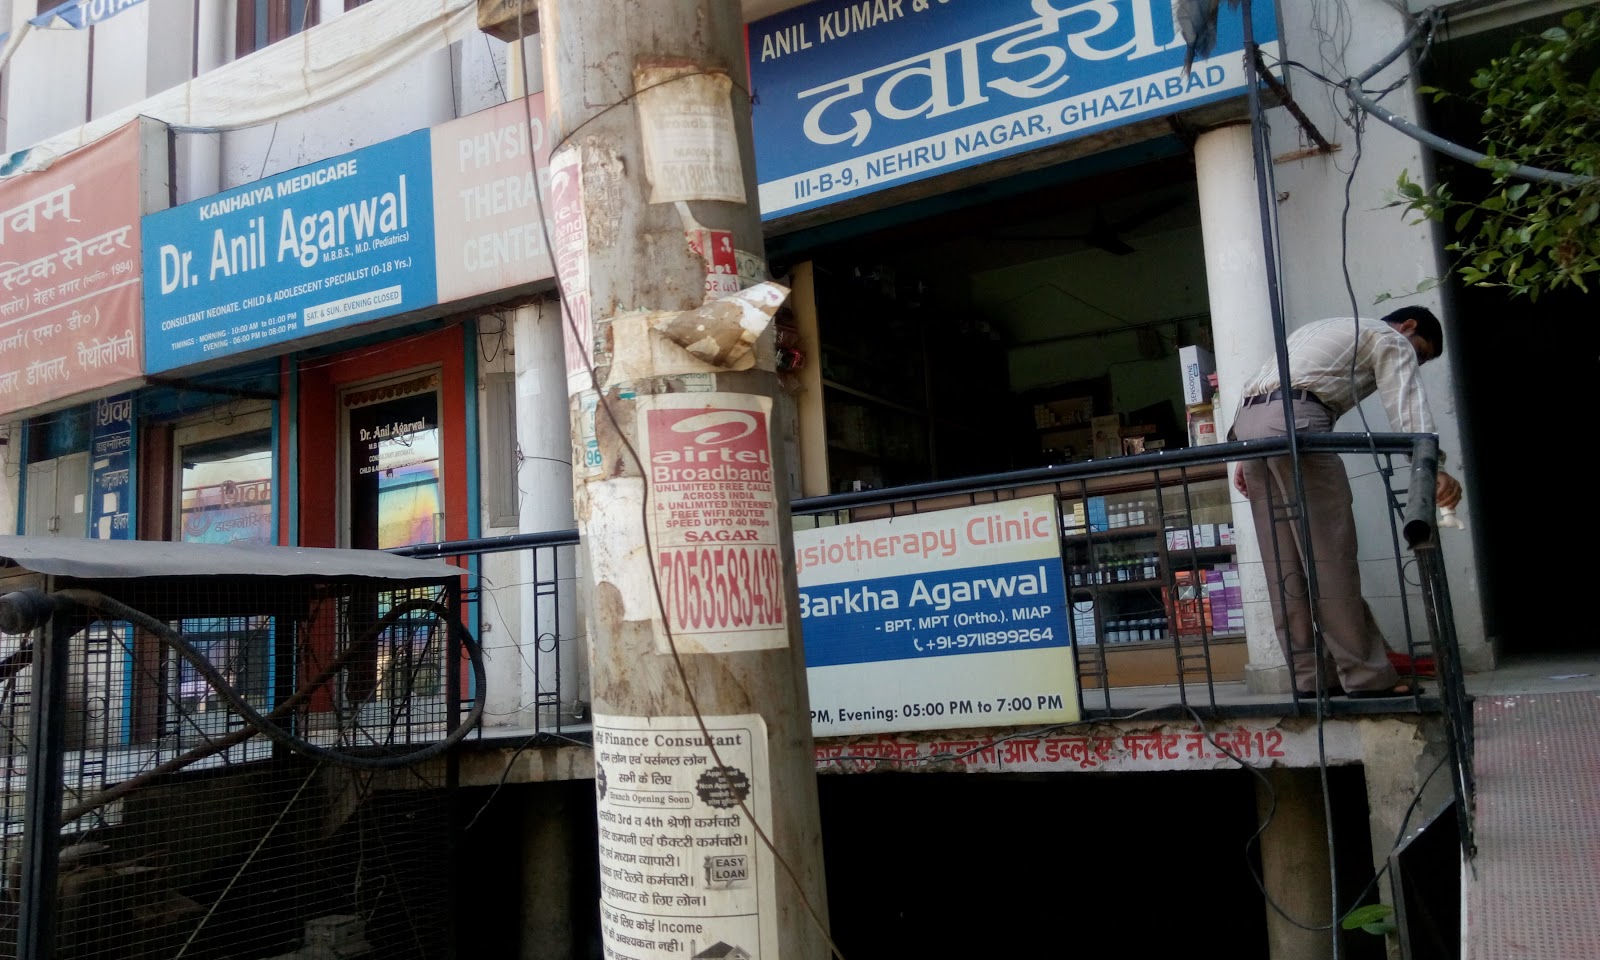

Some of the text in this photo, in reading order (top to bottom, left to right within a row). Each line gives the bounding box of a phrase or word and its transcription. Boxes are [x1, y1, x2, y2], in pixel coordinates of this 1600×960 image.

[761, 23, 812, 62] ANIL
[819, 0, 904, 43] KUMAR
[794, 65, 1225, 199] III-B-9, NEHRU NAGAR, GHAZIABAD
[458, 117, 543, 173] PHYSIO
[200, 159, 357, 221] KANHAIYA MEDICARE
[460, 166, 552, 222] THERAP
[160, 174, 408, 295] Dr. Anil Agarwal
[355, 241, 371, 254] M.D.
[373, 230, 409, 251] (Pediatrics)
[161, 310, 205, 331] CONSULTANT
[243, 295, 265, 310] CHILD
[266, 295, 272, 303] &
[274, 280, 322, 302] ADOLESCENT
[325, 267, 369, 288] SPECIALIST
[371, 261, 392, 277] (0-18
[394, 256, 412, 270] Yrs.)
[306, 311, 319, 321] SAT.
[326, 306, 341, 317] SUN.
[344, 298, 372, 313] EVENING
[373, 290, 399, 305] CLOSED
[171, 311, 297, 350] TIMINGS MORNING 10:00 AM to 01:00 PM
[203, 321, 297, 352] EVENING 06:00 PM to 08:00 PM
[1187, 363, 1197, 403] SENSODYNE
[360, 428, 371, 441] Dr.
[373, 424, 390, 439] Anil
[391, 416, 425, 437] Agarwal
[652, 446, 770, 465] airtel
[654, 464, 771, 483] Broadband
[656, 482, 771, 493] UNLIMITED FREE CALLS
[683, 491, 755, 500] ACROSS INDIA
[657, 500, 773, 511] & UNLIMITED INTERNET
[671, 509, 765, 519] FREE WIFI ROUTER
[666, 518, 770, 528] SPEED UPTO 40 Mbps
[966, 511, 1050, 546] Clinic
[684, 530, 760, 542] SAGAR
[908, 565, 1048, 611] Agarwal
[918, 614, 949, 630] MPT
[1012, 605, 1052, 622] MIAP
[926, 627, 1054, 651] +91-9711899264
[839, 707, 899, 722] Evening:
[902, 702, 945, 718] 05:00
[949, 700, 973, 715] PM
[977, 700, 992, 713] to
[996, 696, 1032, 712] 7:00
[1037, 695, 1063, 710] PM
[605, 732, 649, 747] Finance
[629, 752, 643, 765] एवं
[644, 752, 680, 766] पर्सनल
[683, 754, 708, 766] लोन
[618, 771, 672, 785] सभी के लिए
[706, 769, 738, 779] Apprved
[610, 791, 690, 805] Branch Opening Soon
[618, 813, 632, 825] 3rd
[644, 816, 663, 828] 4th
[694, 813, 741, 828] कर्मचारी
[611, 832, 637, 846] कम्पनी
[640, 833, 654, 847] एवं
[716, 857, 745, 868] EASY
[624, 868, 644, 884] रेलवे
[716, 869, 745, 879] LOAN
[639, 890, 649, 904] के
[652, 892, 673, 907] लिए
[636, 918, 656, 933] कोई
[658, 920, 703, 934] Income
